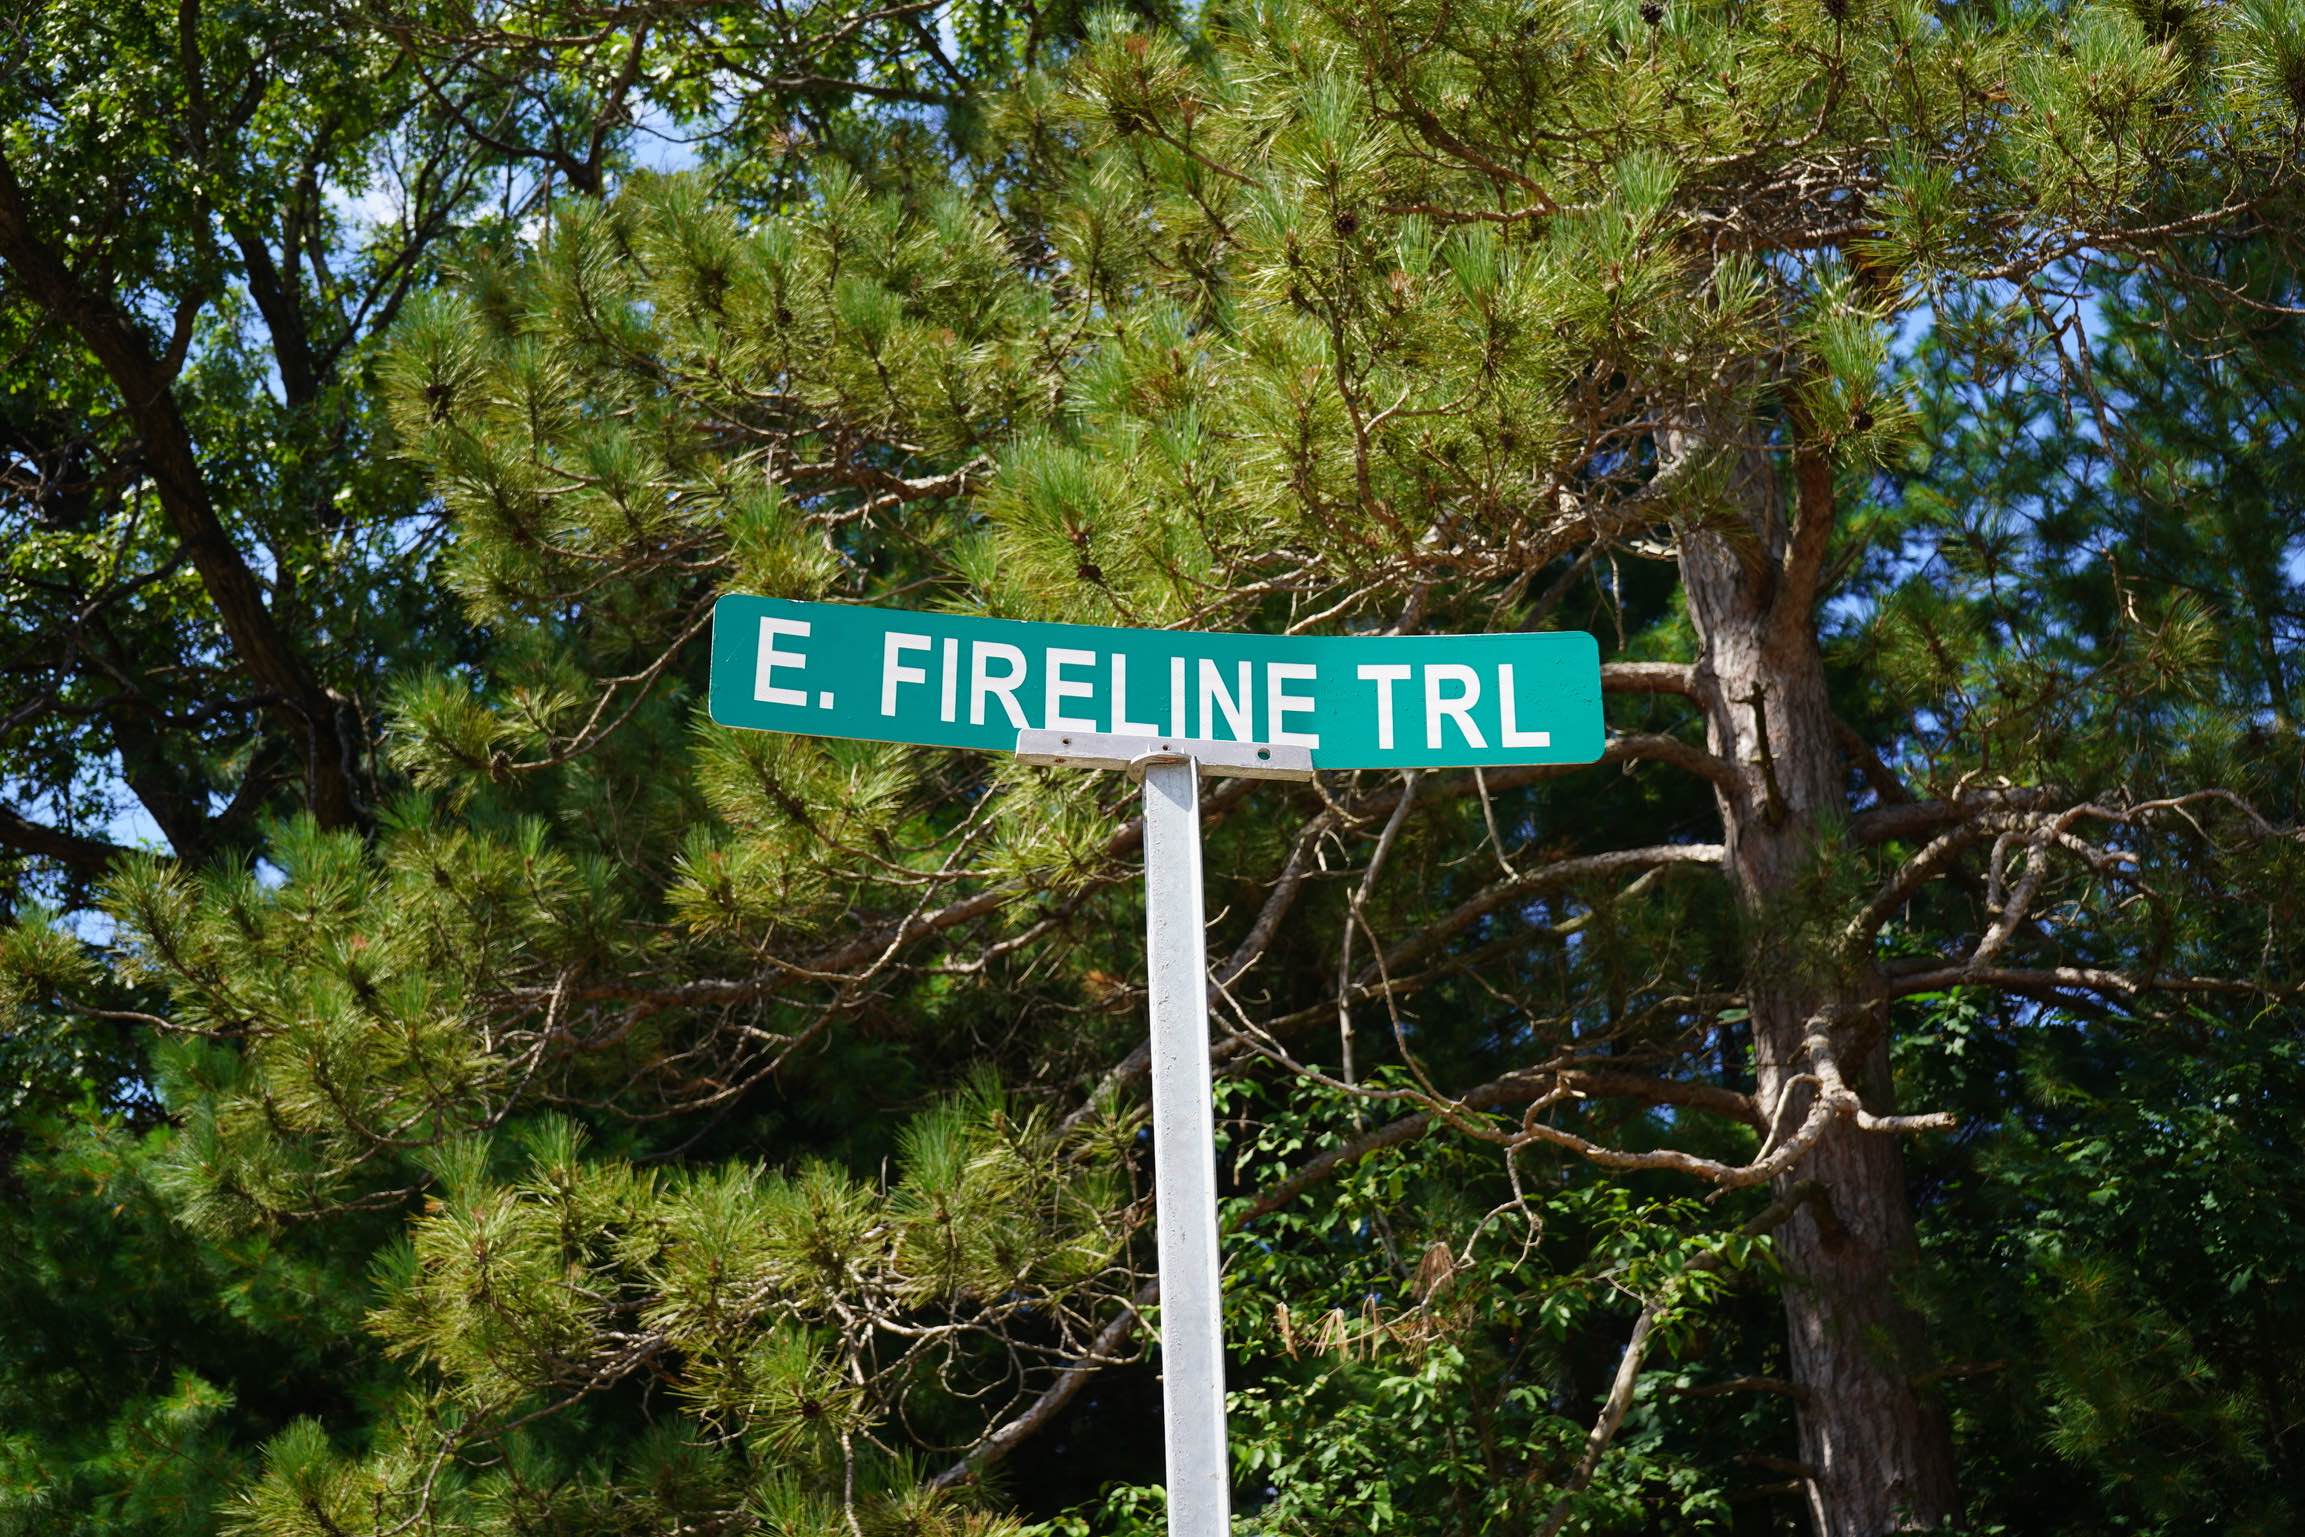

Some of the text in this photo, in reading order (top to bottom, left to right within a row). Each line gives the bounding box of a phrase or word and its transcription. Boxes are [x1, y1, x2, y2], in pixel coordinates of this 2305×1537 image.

[754, 616, 1550, 749] E. FIRELINE TRL
